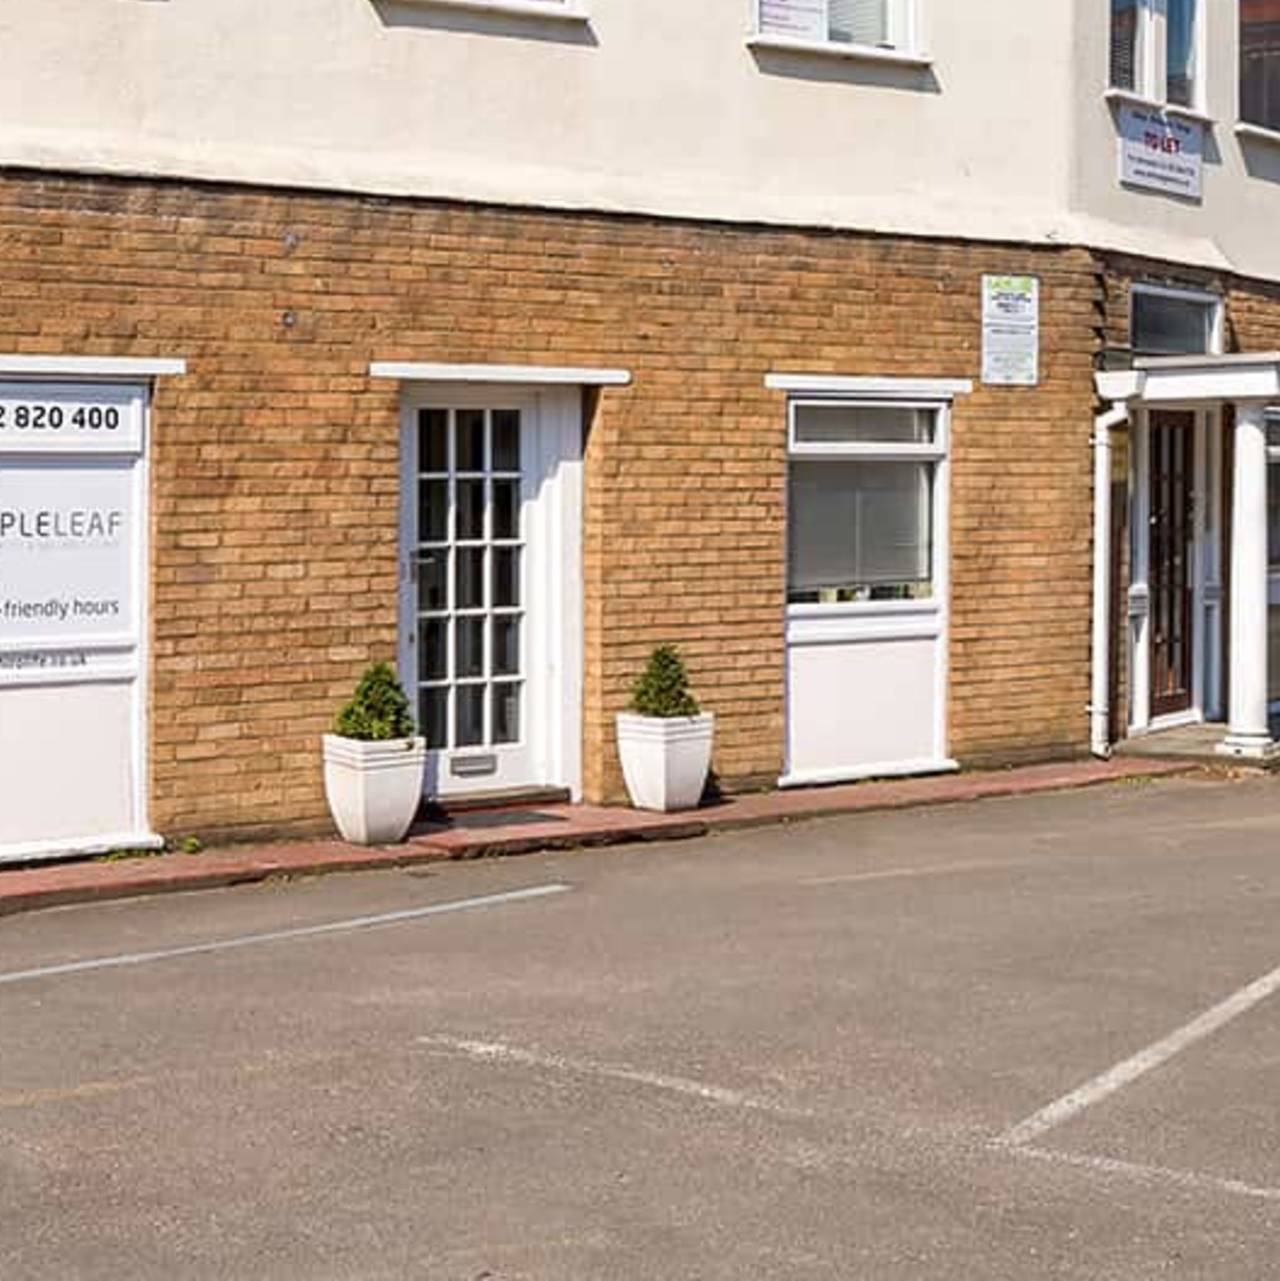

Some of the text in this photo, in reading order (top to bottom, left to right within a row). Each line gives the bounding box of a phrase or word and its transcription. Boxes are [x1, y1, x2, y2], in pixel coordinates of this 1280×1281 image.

[14, 405, 64, 430] 820
[71, 406, 120, 430] 400
[72, 598, 120, 616] hours
